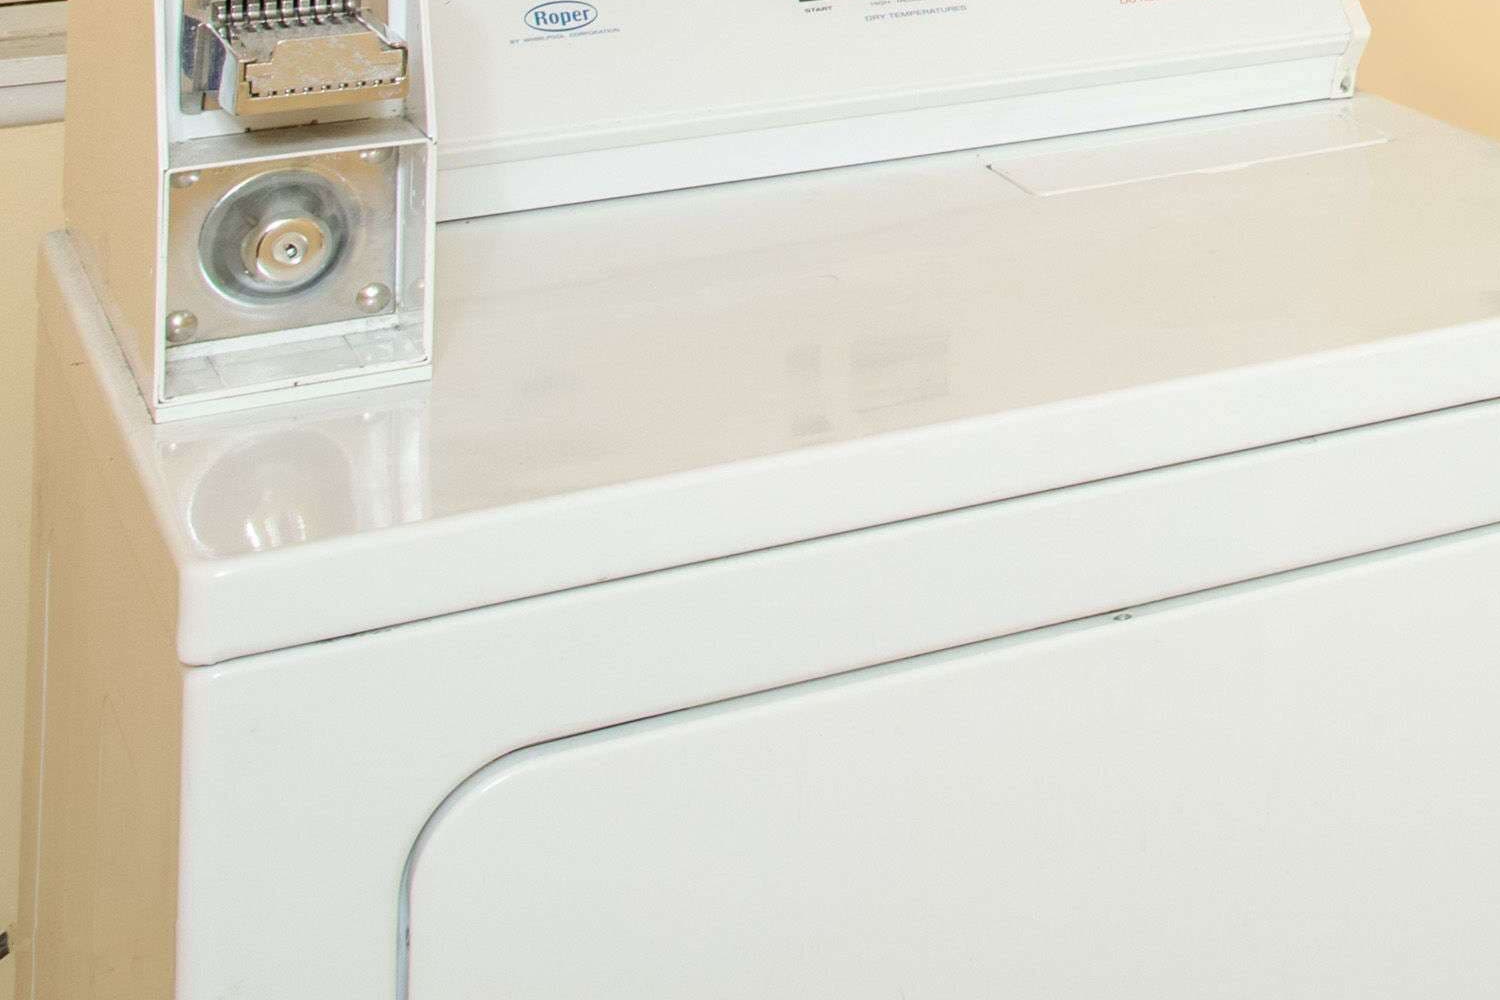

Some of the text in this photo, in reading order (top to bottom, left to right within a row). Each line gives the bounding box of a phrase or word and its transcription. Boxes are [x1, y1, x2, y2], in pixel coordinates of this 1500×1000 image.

[533, 8, 590, 26] Roper
[804, 5, 833, 13] START
[864, 4, 967, 22] DRY TEMPERATURES
